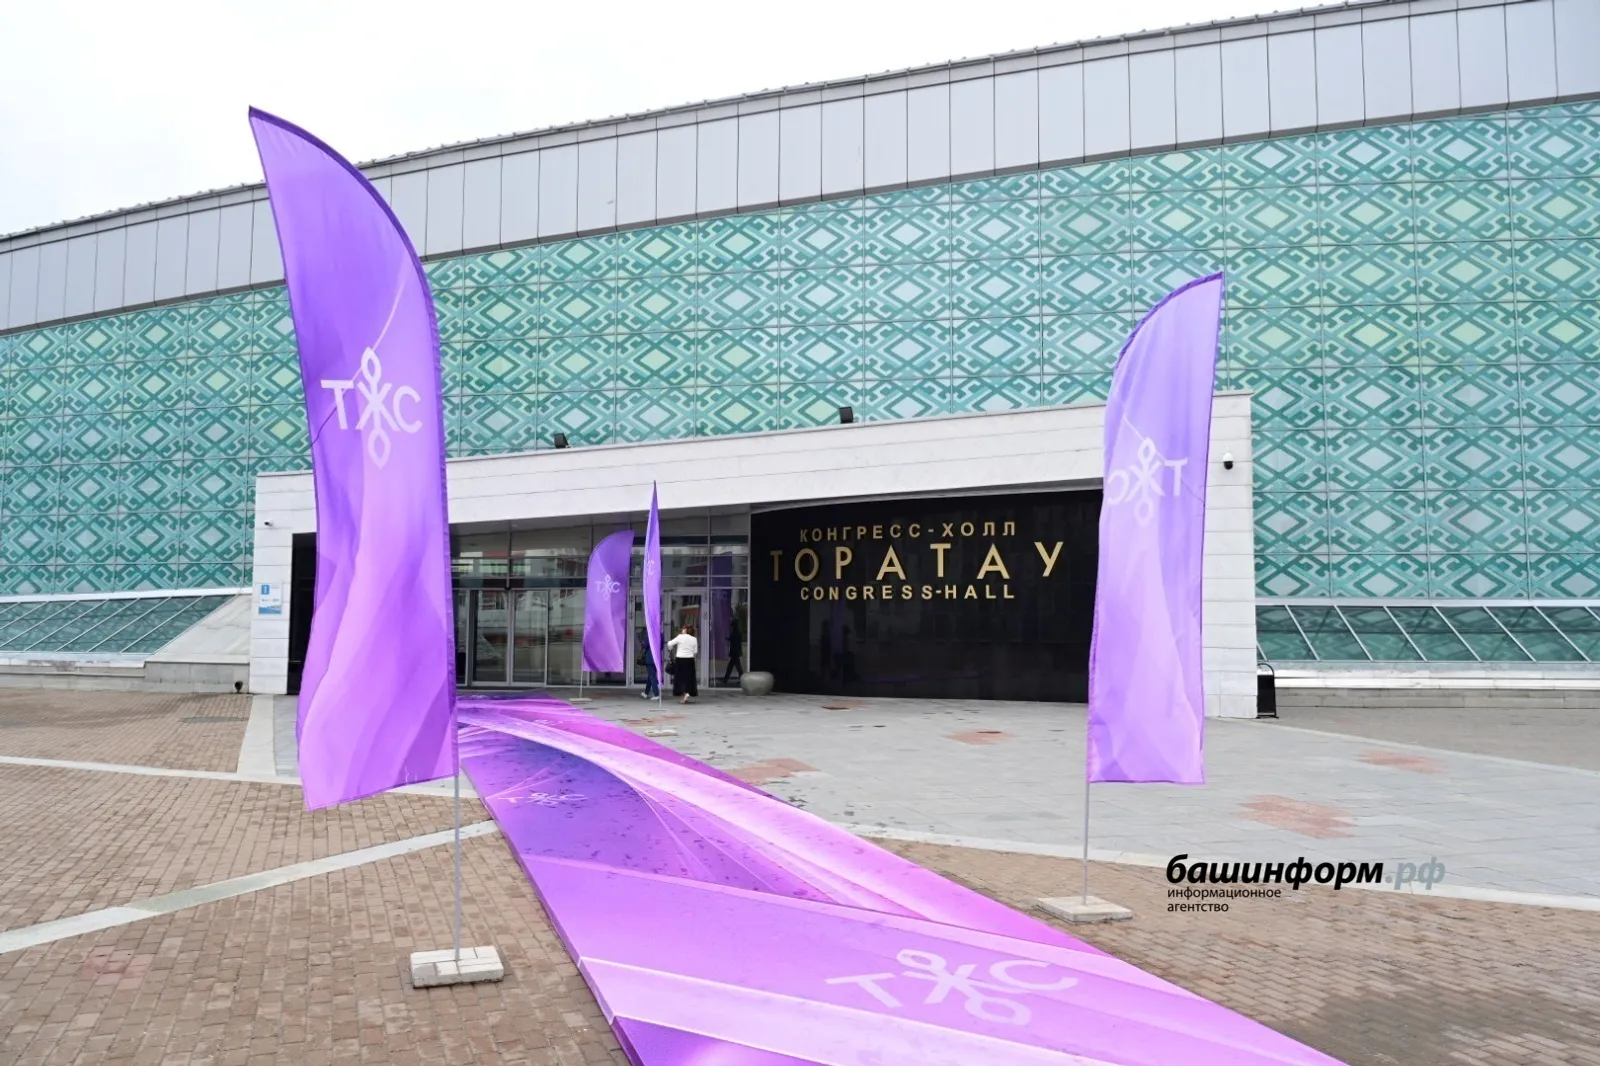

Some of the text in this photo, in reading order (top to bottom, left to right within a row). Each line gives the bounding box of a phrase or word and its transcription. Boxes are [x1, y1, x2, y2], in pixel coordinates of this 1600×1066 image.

[800, 521, 1015, 542] КОНГРЕСС-ХОЛЛ
[770, 541, 1064, 581] ТОРАТАУ
[800, 584, 1015, 600] CONGRESS-HALL
